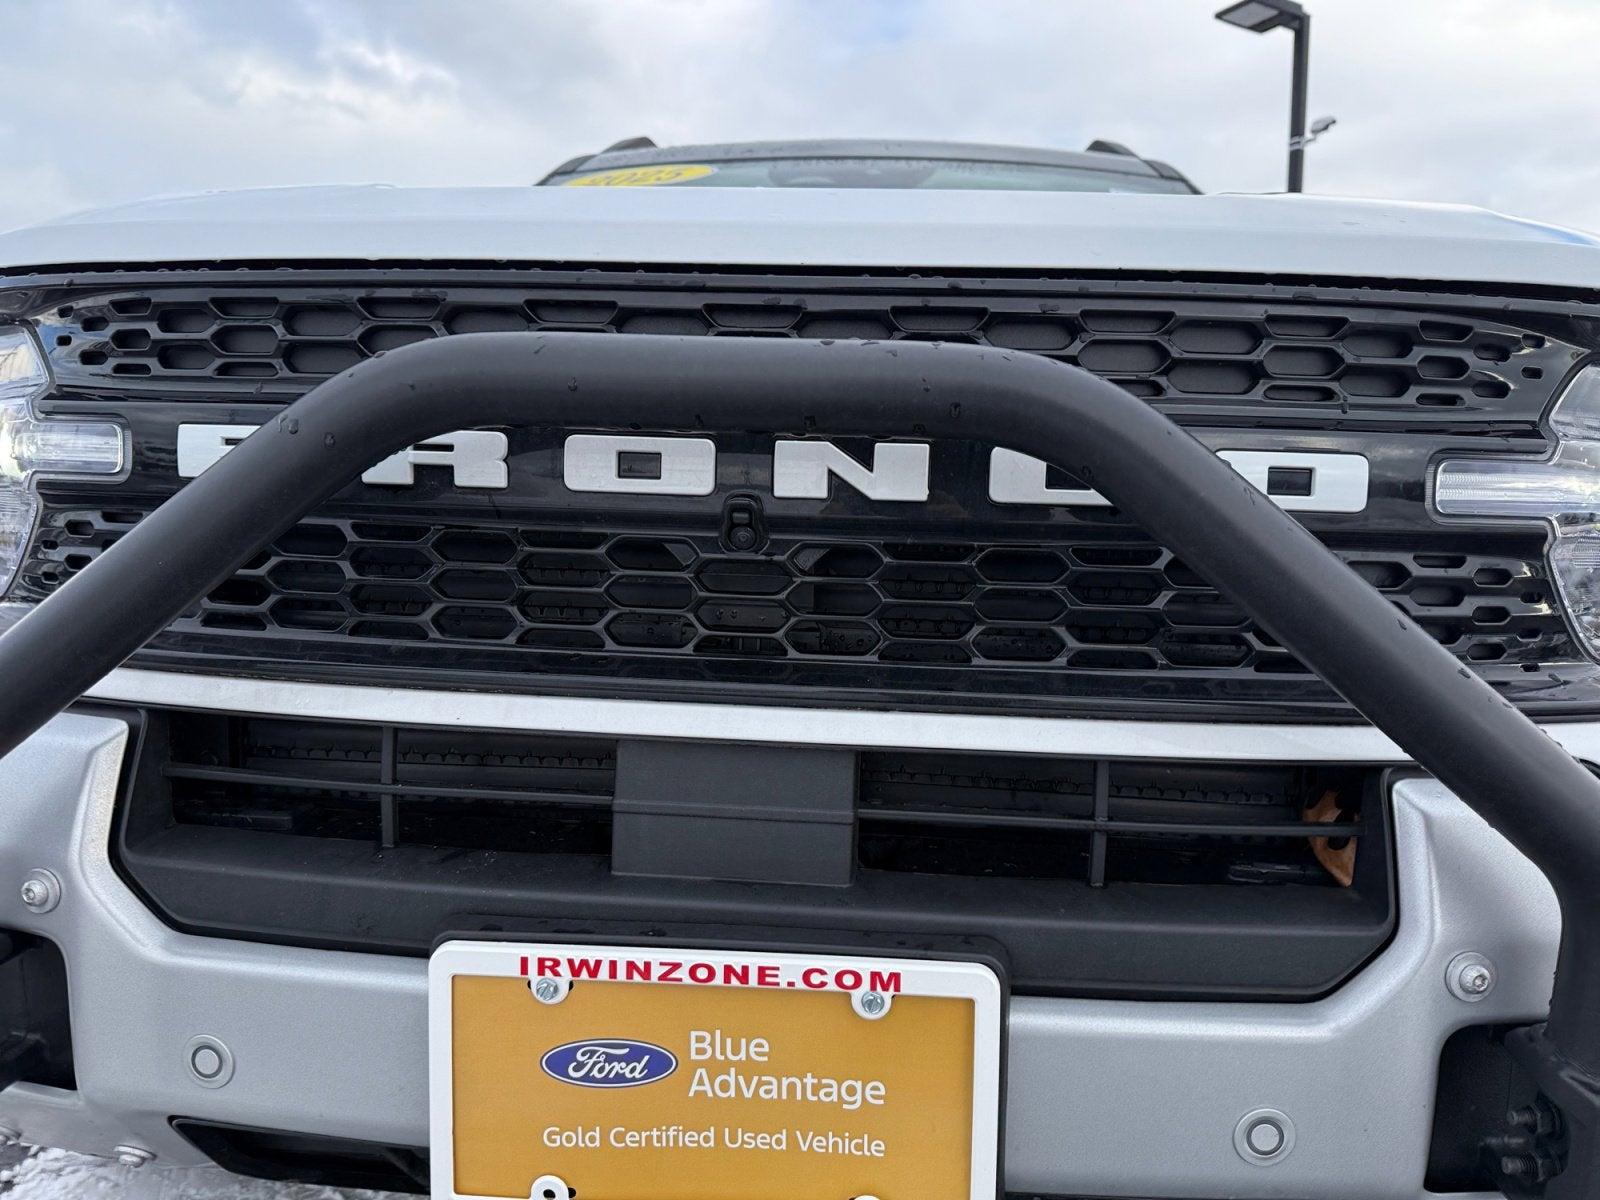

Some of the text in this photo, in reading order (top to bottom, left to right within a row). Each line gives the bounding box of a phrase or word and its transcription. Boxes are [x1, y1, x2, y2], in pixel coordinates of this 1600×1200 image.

[520, 956, 901, 992] IRWINZONE.COM
[690, 1030, 769, 1061] Blue
[567, 1046, 650, 1079] Ford
[689, 1068, 885, 1109] Advantage
[543, 1126, 885, 1156] Gold Certified Used Vehicle
